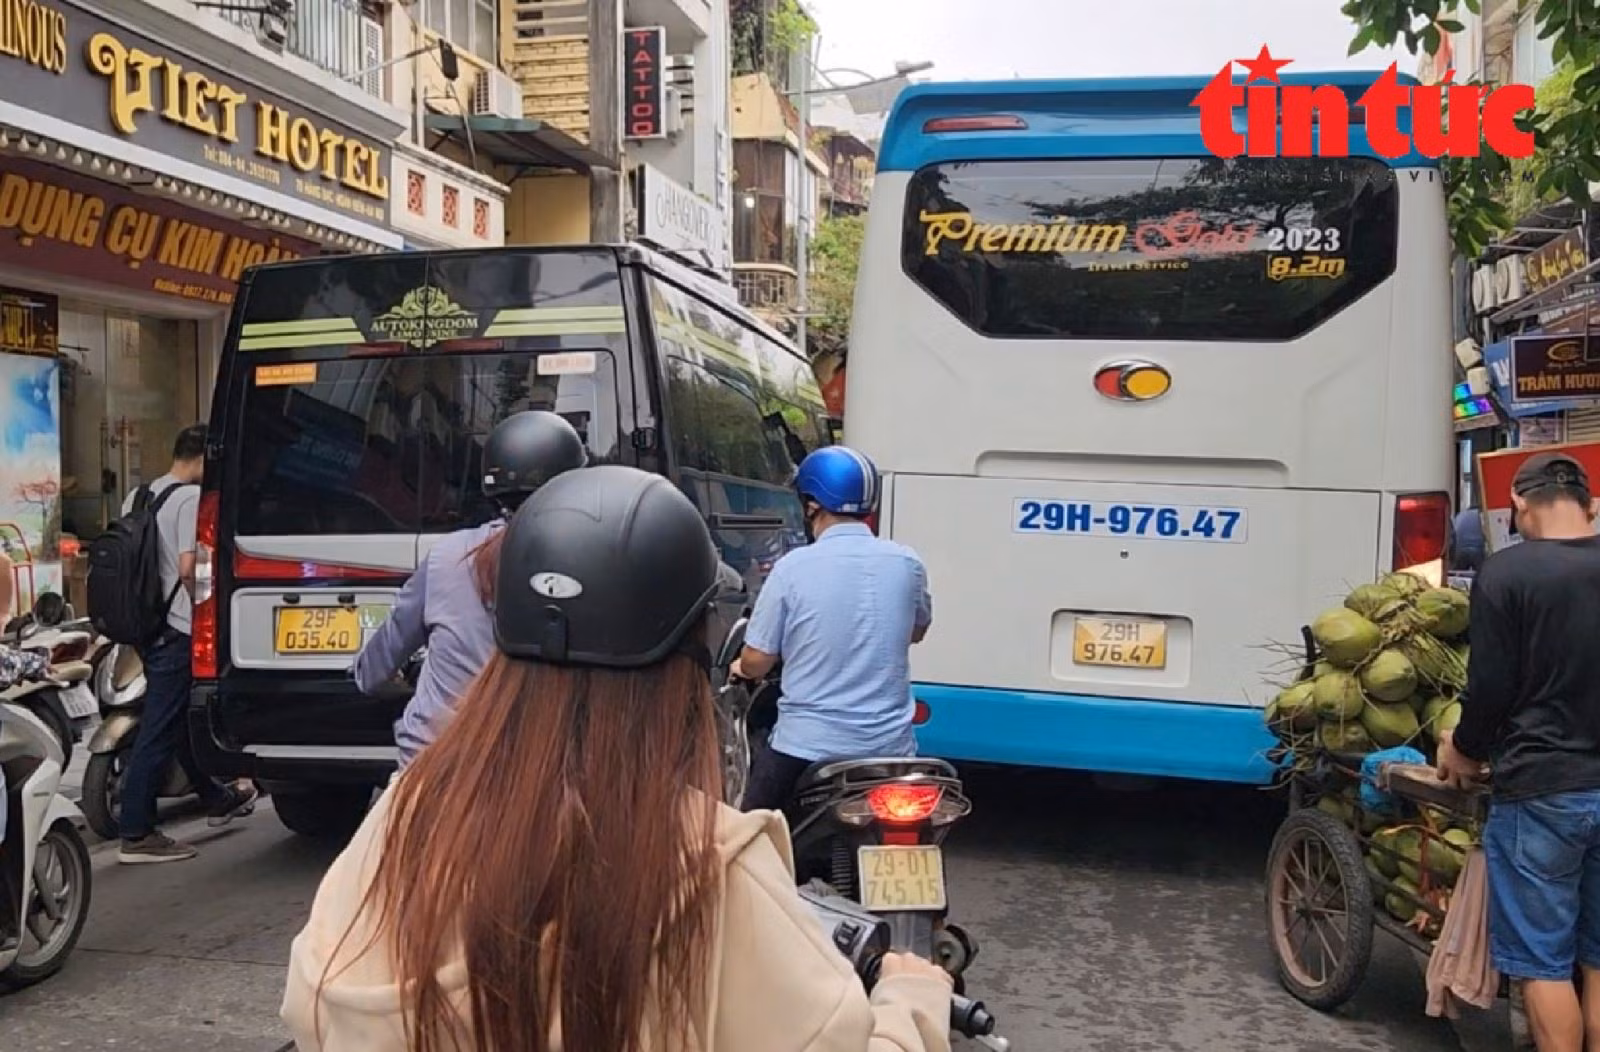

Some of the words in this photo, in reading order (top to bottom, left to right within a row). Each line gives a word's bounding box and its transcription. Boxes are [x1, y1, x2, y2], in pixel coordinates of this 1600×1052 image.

[0, 0, 67, 74] INOUS
[632, 31, 653, 137] TATTOO
[86, 32, 247, 143] VIET
[255, 100, 389, 200] HOTEL
[0, 174, 106, 247] DỤNG
[108, 206, 160, 269] CỤ
[158, 220, 225, 276] KIM
[221, 236, 301, 281] HOÀ
[920, 210, 1128, 256] Premium
[1267, 227, 1341, 251] 2023
[1271, 256, 1346, 276] 8.2m
[370, 318, 479, 332] AUTOKINGDOM
[388, 329, 459, 340] LIMOSINE
[1019, 501, 1241, 538] 29H-976.47
[303, 609, 336, 628] 29F
[286, 630, 349, 649] 035.40
[1101, 622, 1140, 642] 29H
[1083, 643, 1155, 664] 976.47
